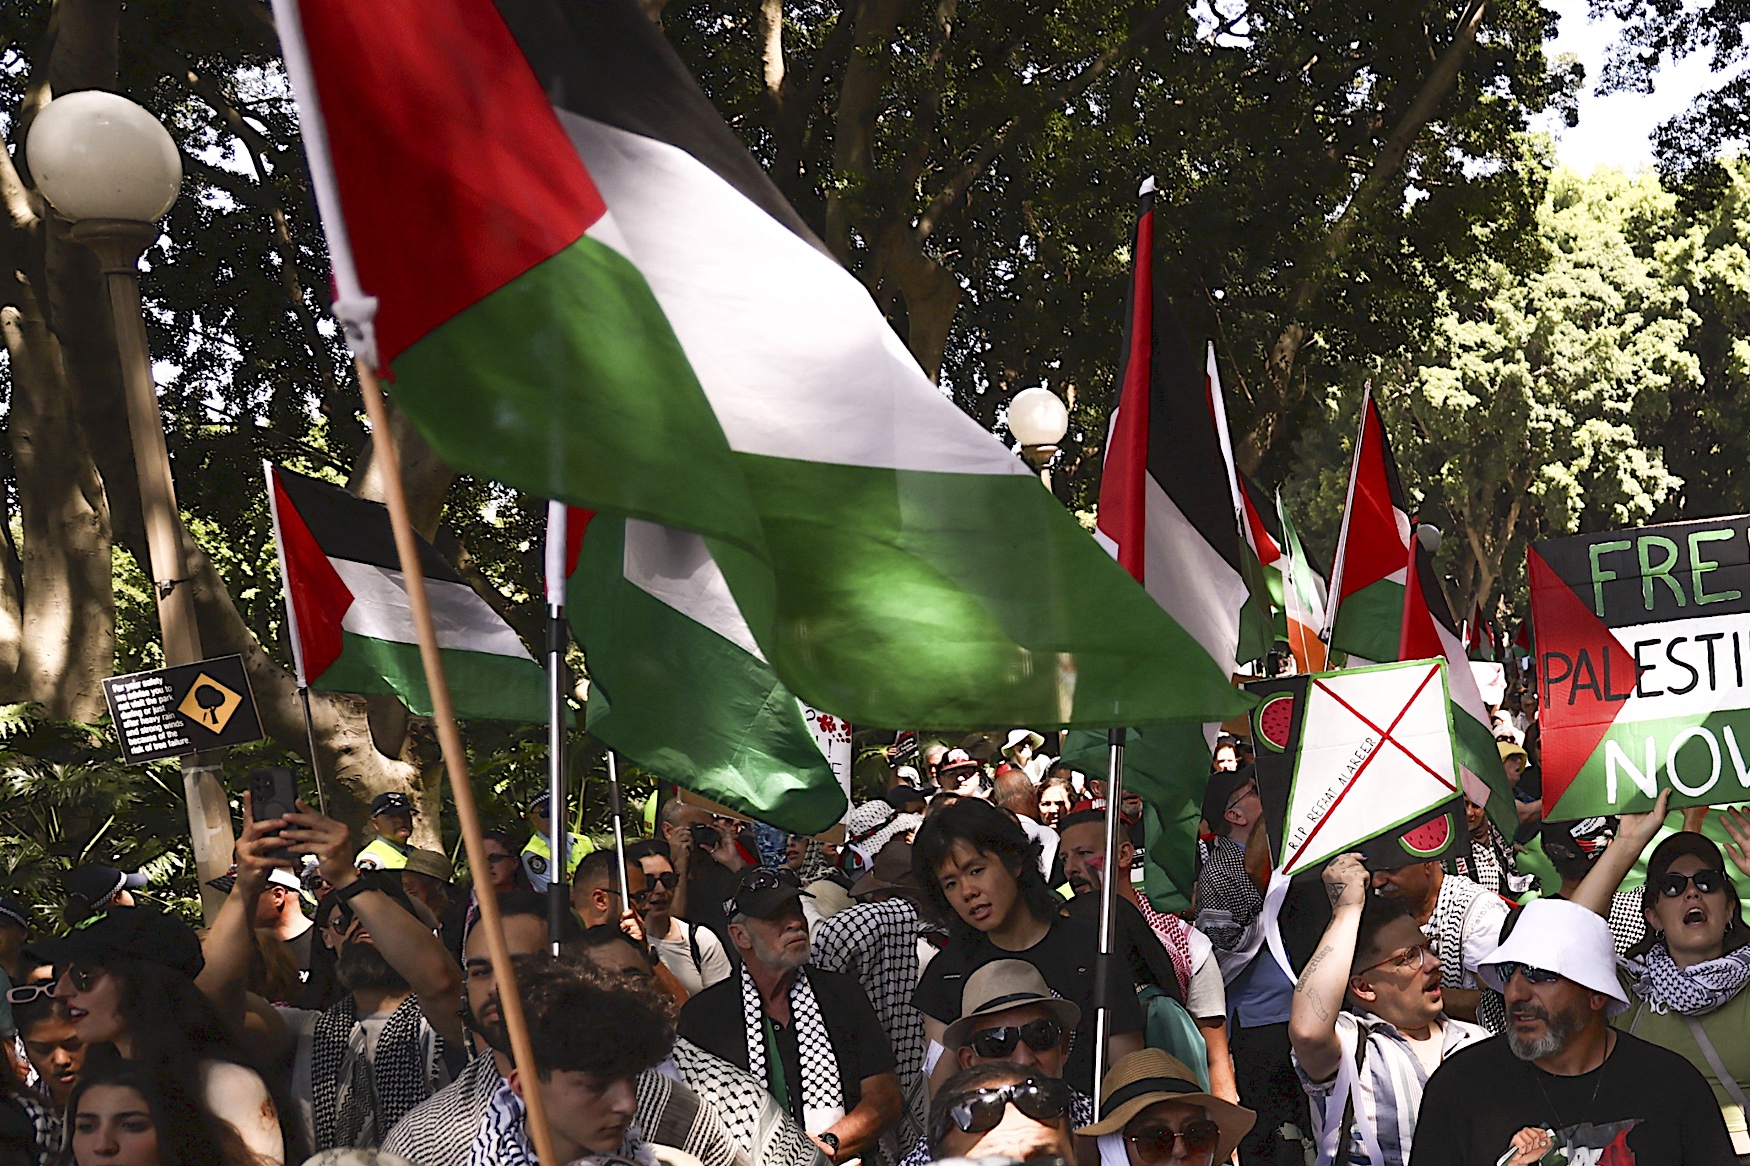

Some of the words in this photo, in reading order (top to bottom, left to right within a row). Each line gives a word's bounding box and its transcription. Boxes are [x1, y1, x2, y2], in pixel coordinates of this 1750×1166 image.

[150, 688, 164, 698] you
[165, 685, 172, 693] to
[146, 697, 157, 705] the
[159, 694, 173, 704] park
[152, 704, 166, 714] just
[141, 715, 161, 725] heavy
[162, 712, 176, 721] rain
[126, 728, 139, 737] and
[140, 724, 163, 734] strong
[163, 721, 184, 730] winds
[127, 734, 157, 746] because
[166, 730, 178, 738] the
[1307, 787, 1338, 823] REFAAT
[1338, 737, 1376, 786] ALAREER
